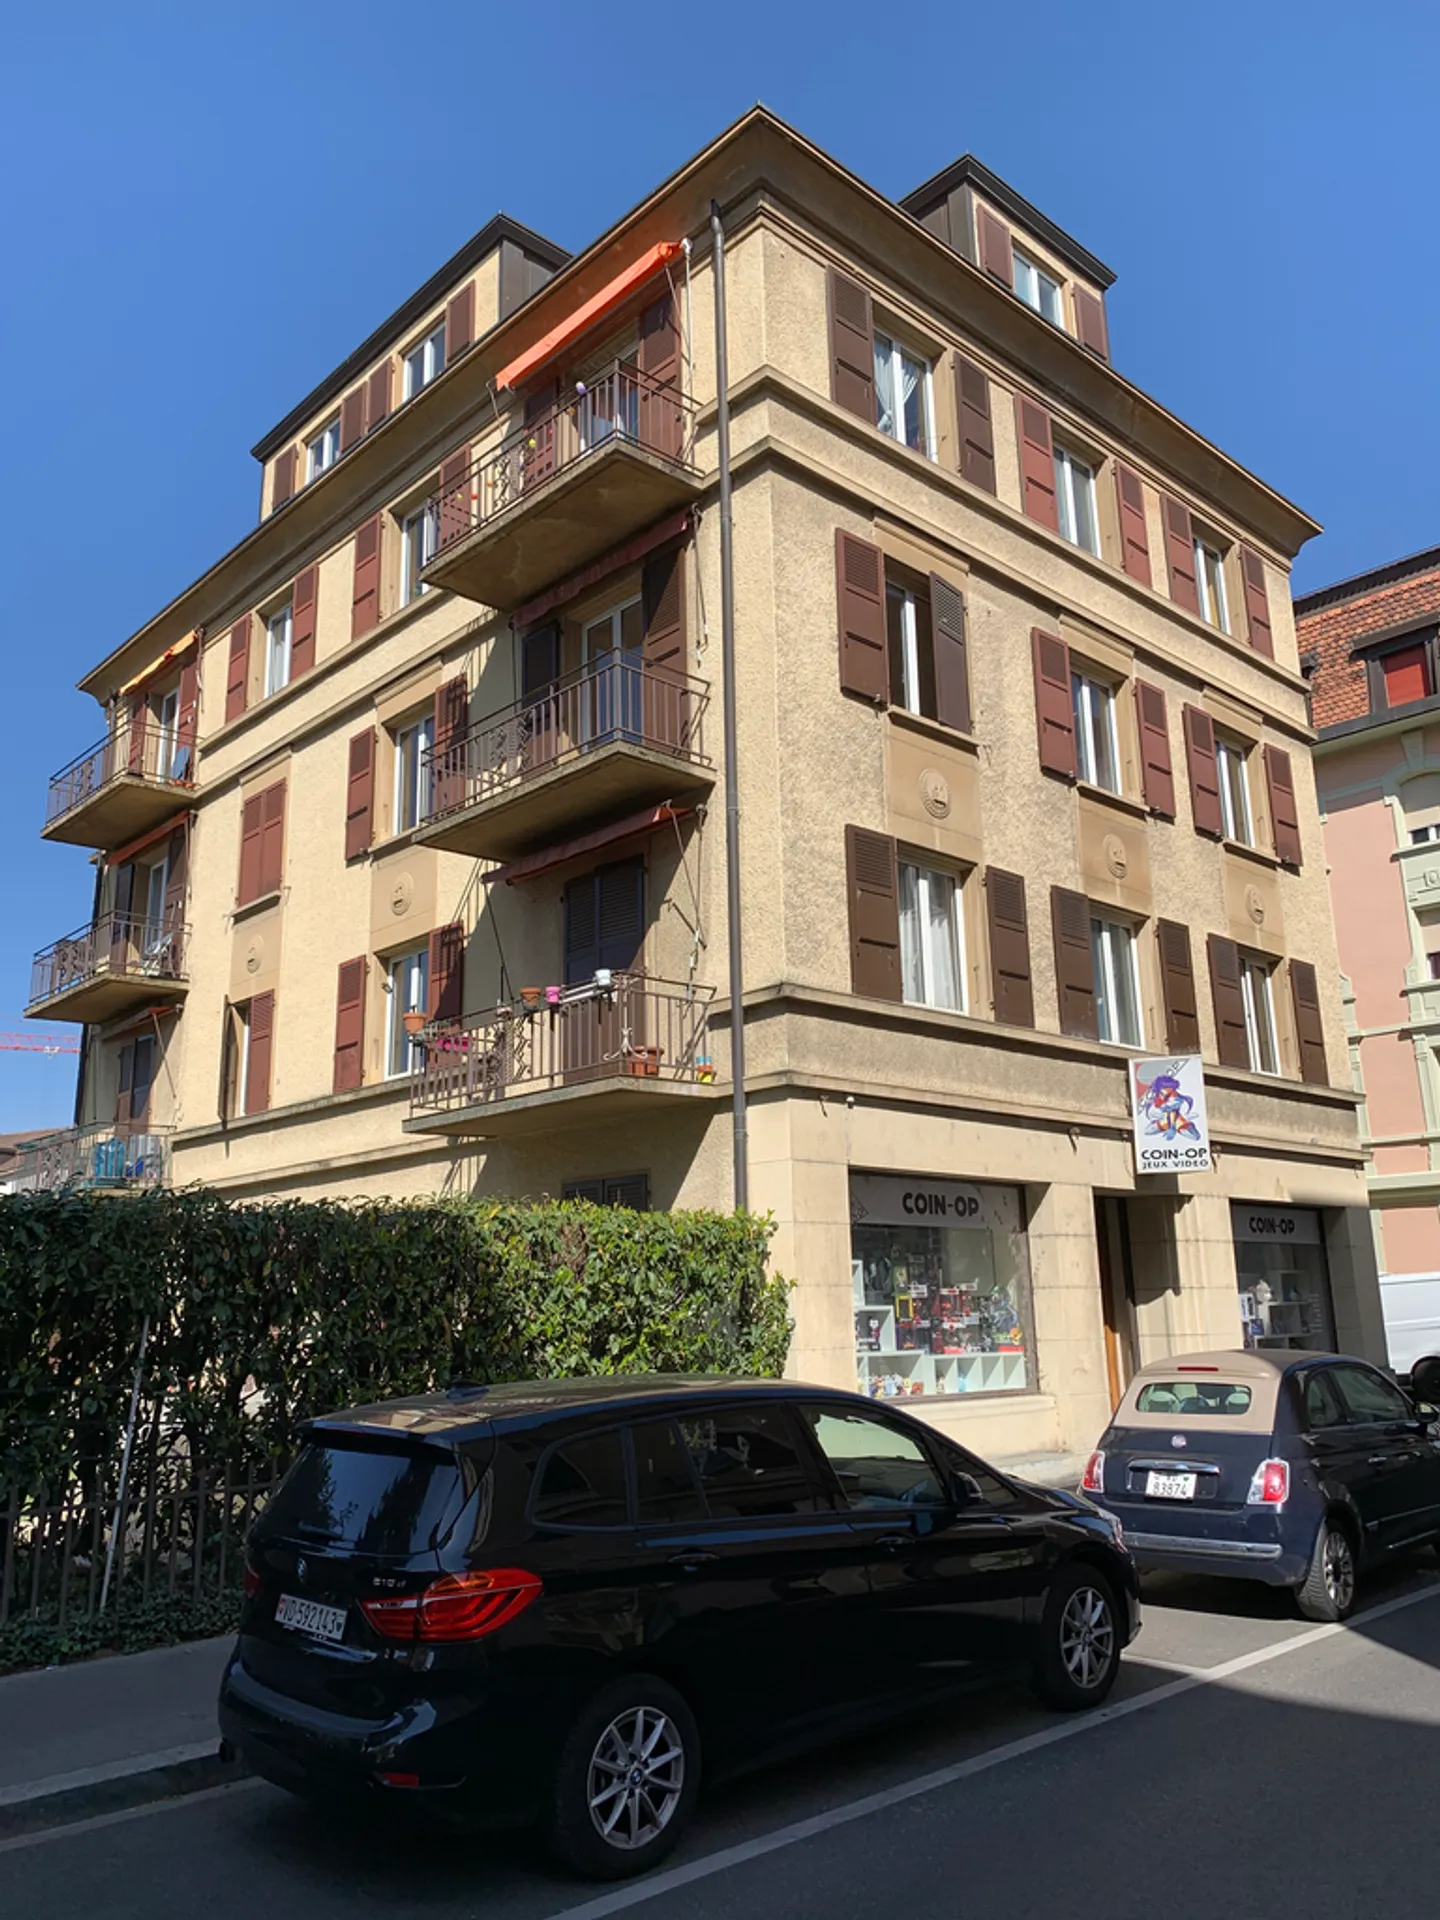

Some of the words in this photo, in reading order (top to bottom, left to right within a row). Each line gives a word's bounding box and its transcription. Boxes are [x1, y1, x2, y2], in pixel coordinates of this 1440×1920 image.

[1141, 1148, 1207, 1160] COIN-OP
[1142, 1162, 1168, 1170] JEUX
[902, 1192, 979, 1217] COIN-OP
[1248, 1216, 1296, 1235] COIN-OP
